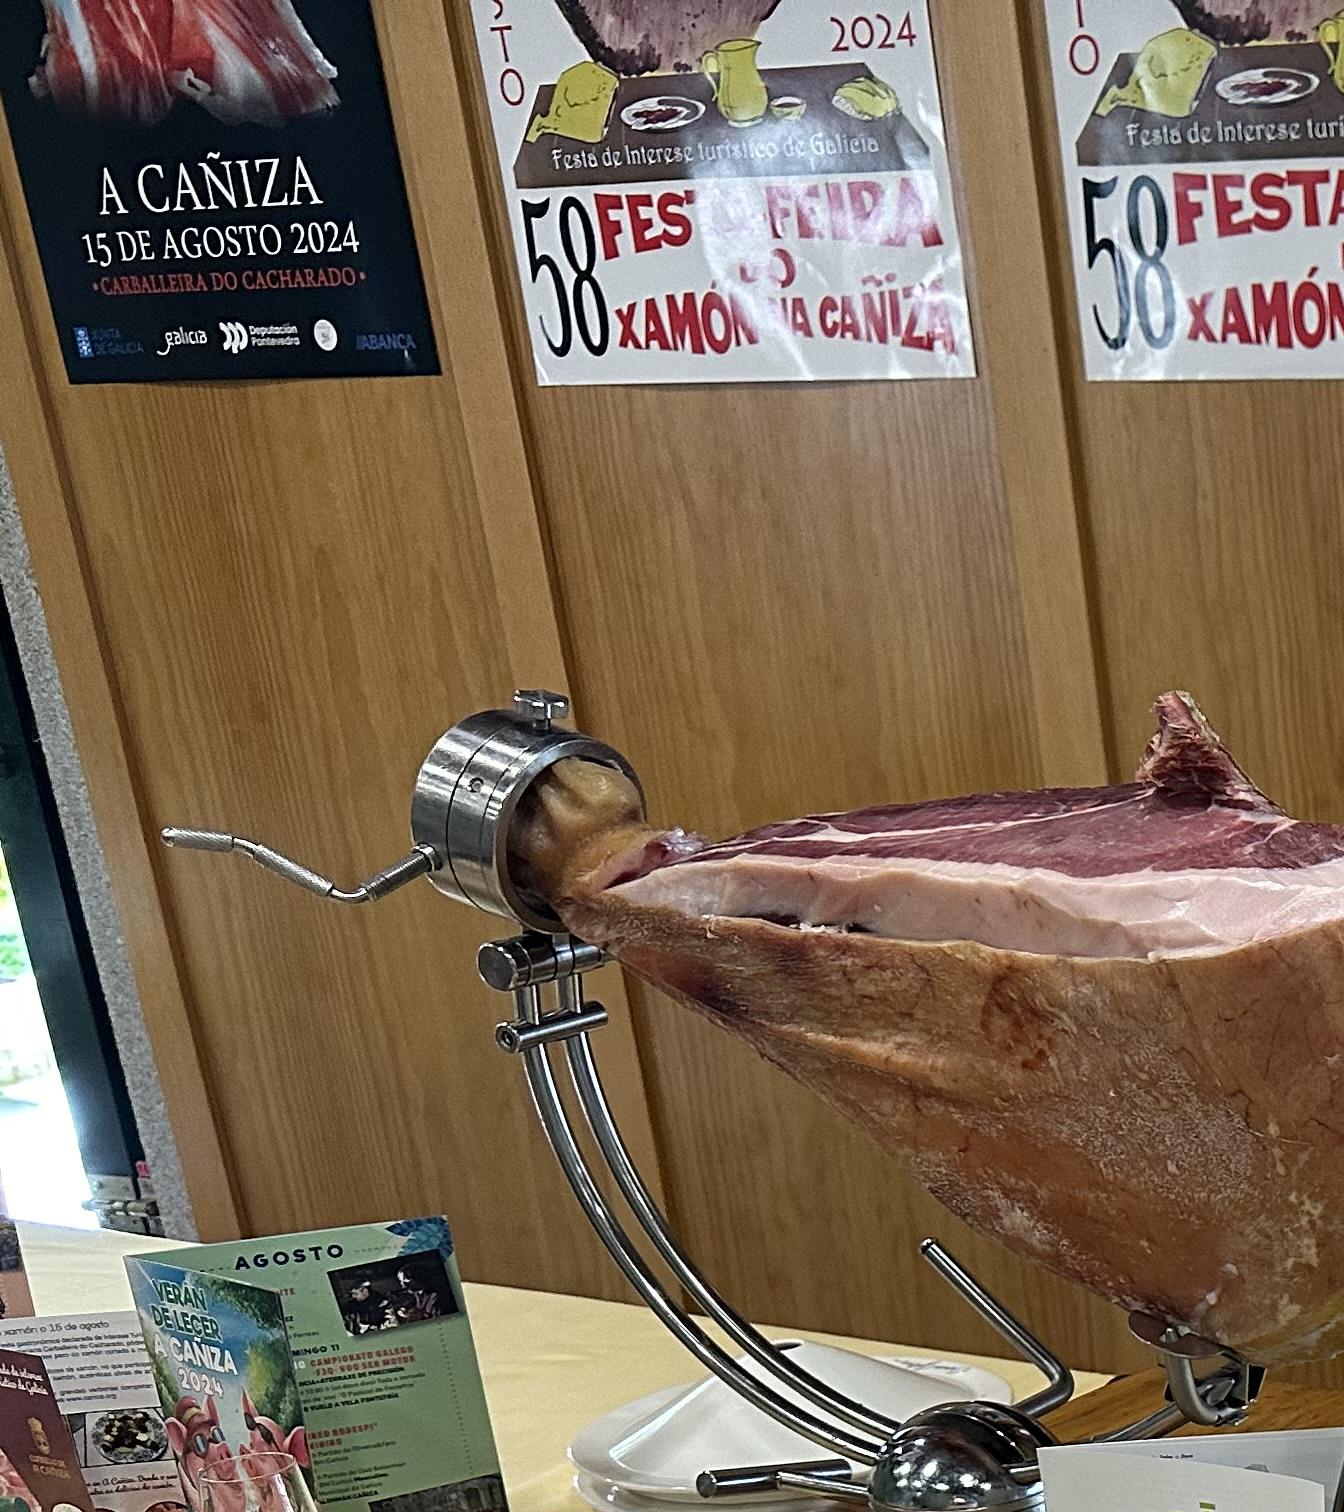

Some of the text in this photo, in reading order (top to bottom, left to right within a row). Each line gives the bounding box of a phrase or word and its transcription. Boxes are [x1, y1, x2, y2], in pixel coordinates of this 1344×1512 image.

[830, 12, 917, 52] 2024
[1125, 122, 1181, 148] Festa
[1185, 120, 1214, 144] de
[1216, 116, 1300, 142] Interese
[551, 144, 693, 170] Festa de Interese
[100, 152, 324, 216] A CAÑIZA
[80, 220, 360, 268] 15 DE AGOSTO 2024
[520, 196, 610, 358] 58
[1080, 174, 1178, 352] 58
[100, 266, 356, 296] CARBALLEIRA DO CACHARADO
[615, 273, 958, 356] XAMÓN CAÑIZA
[156, 327, 207, 356] galicia
[234, 1242, 345, 1271] AGOSTO
[151, 1278, 207, 1311] VERÁN
[64, 1322, 77, 1330] de
[79, 1321, 109, 1331] agosto
[151, 1306, 223, 1343] DE LECER
[168, 1331, 238, 1376] CAÑIZA
[178, 1367, 225, 1399] 2024
